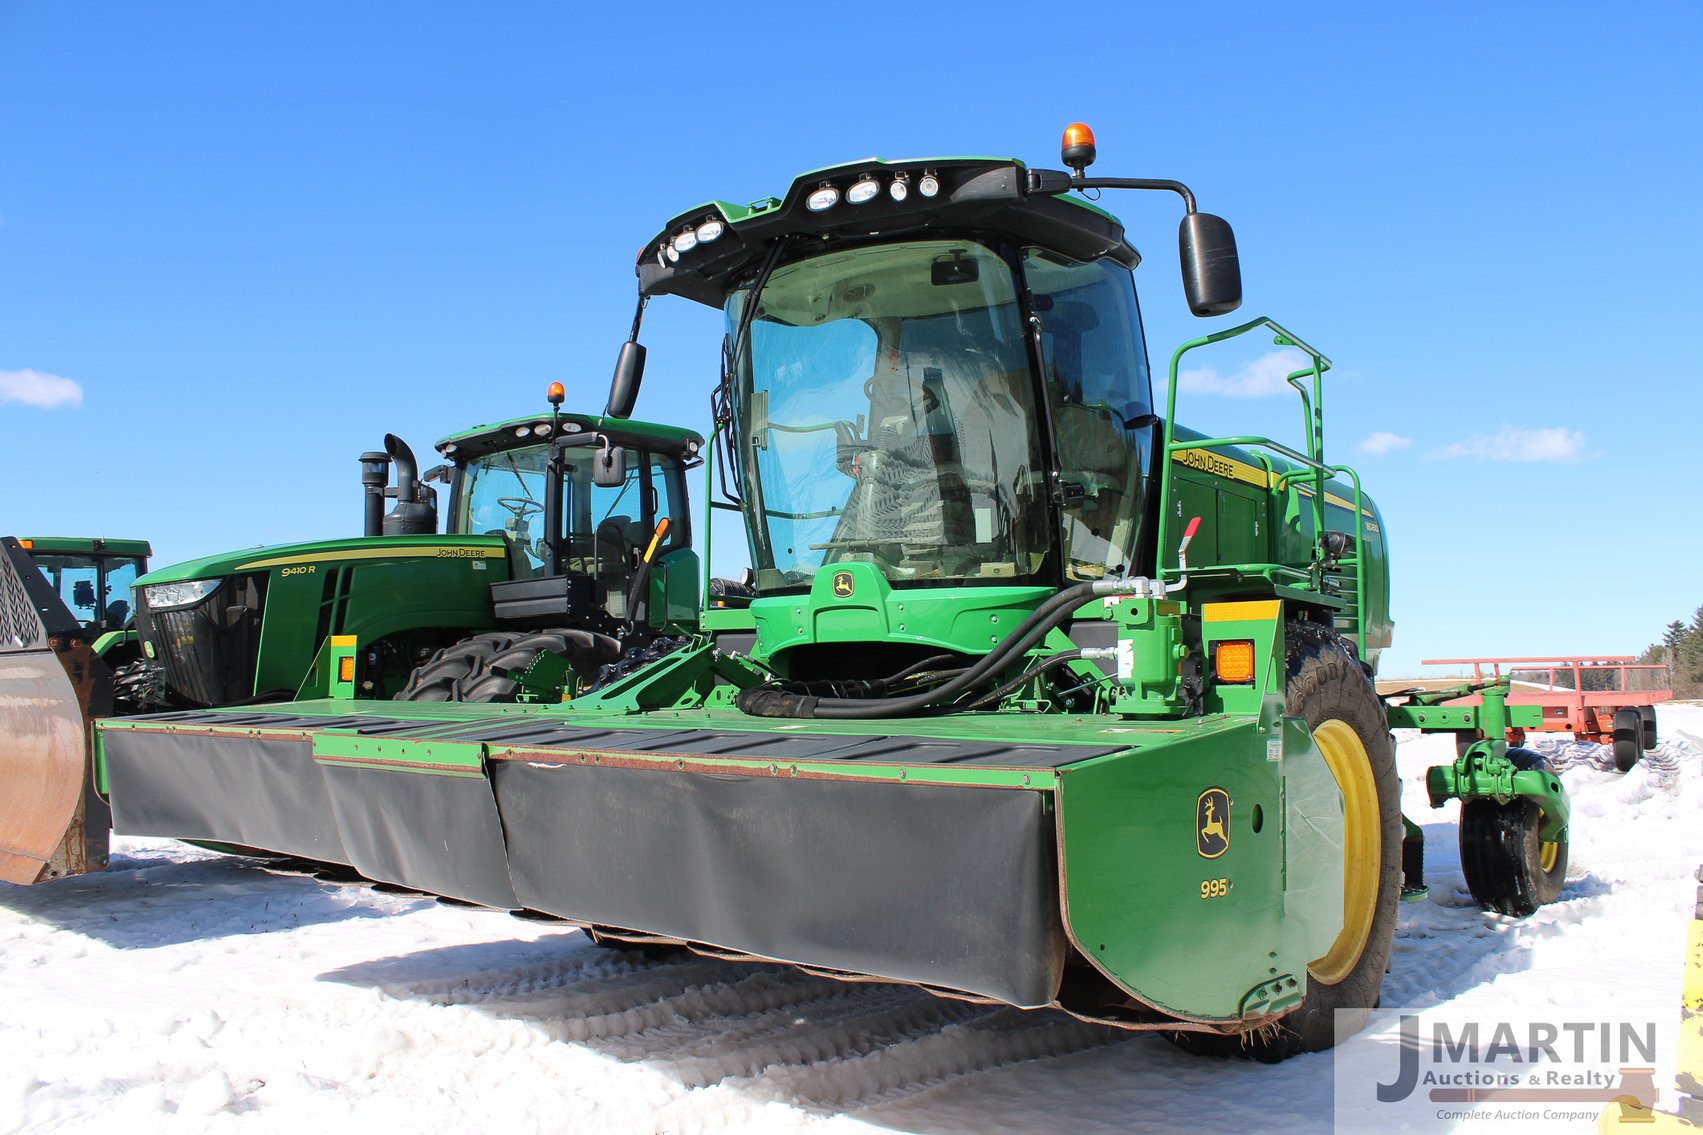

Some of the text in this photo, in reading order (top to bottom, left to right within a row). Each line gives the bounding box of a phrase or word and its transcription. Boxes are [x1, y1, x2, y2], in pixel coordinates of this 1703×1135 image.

[1182, 449, 1234, 477] JOHN DEERE
[437, 548, 486, 557] JOHN DEERE
[281, 565, 316, 577] 9410 R
[1200, 878, 1227, 899] 995
